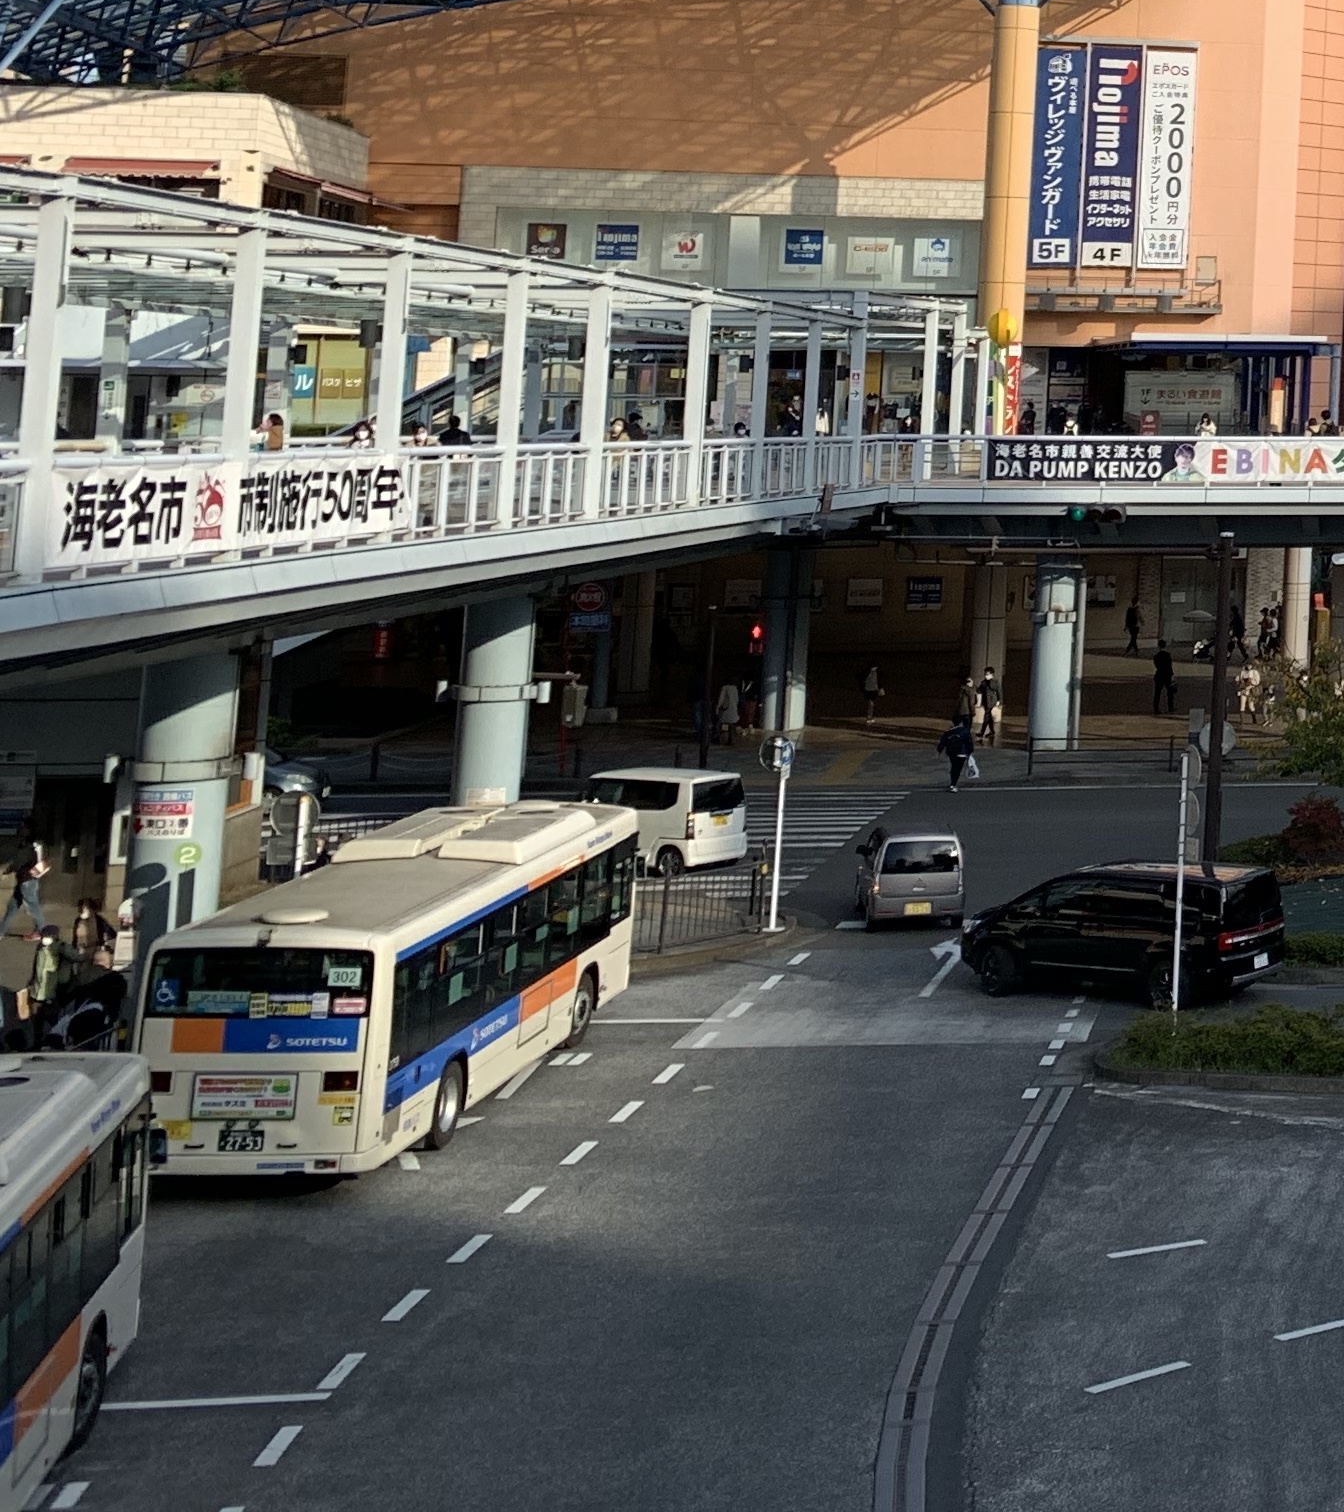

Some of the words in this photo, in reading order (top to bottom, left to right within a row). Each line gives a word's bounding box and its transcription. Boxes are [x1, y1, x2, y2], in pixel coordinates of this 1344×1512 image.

[1153, 65, 1189, 76] EPOS
[1092, 58, 1138, 167] nojima
[1041, 75, 1070, 236] ヴィレッジヴァンガード
[1149, 104, 1164, 225] ご優待クーポンプレゼント
[1165, 103, 1186, 225] 2000円分
[1088, 190, 1131, 201] 生活家電
[1086, 203, 1132, 215] インターネット
[1086, 217, 1130, 227] アクセサリ
[1149, 233, 1177, 241] 入会金
[1038, 241, 1066, 259] 5F
[995, 443, 1162, 459] 海老名市親善交流大使
[994, 460, 1024, 478] DA
[1029, 461, 1090, 478] PUMP
[1094, 461, 1163, 478] KENZO
[237, 464, 403, 537] 市制施行50周年
[60, 475, 188, 552] 海老名市
[179, 846, 196, 864] 2
[332, 970, 358, 984] 302
[286, 1037, 348, 1047] SOTETSU
